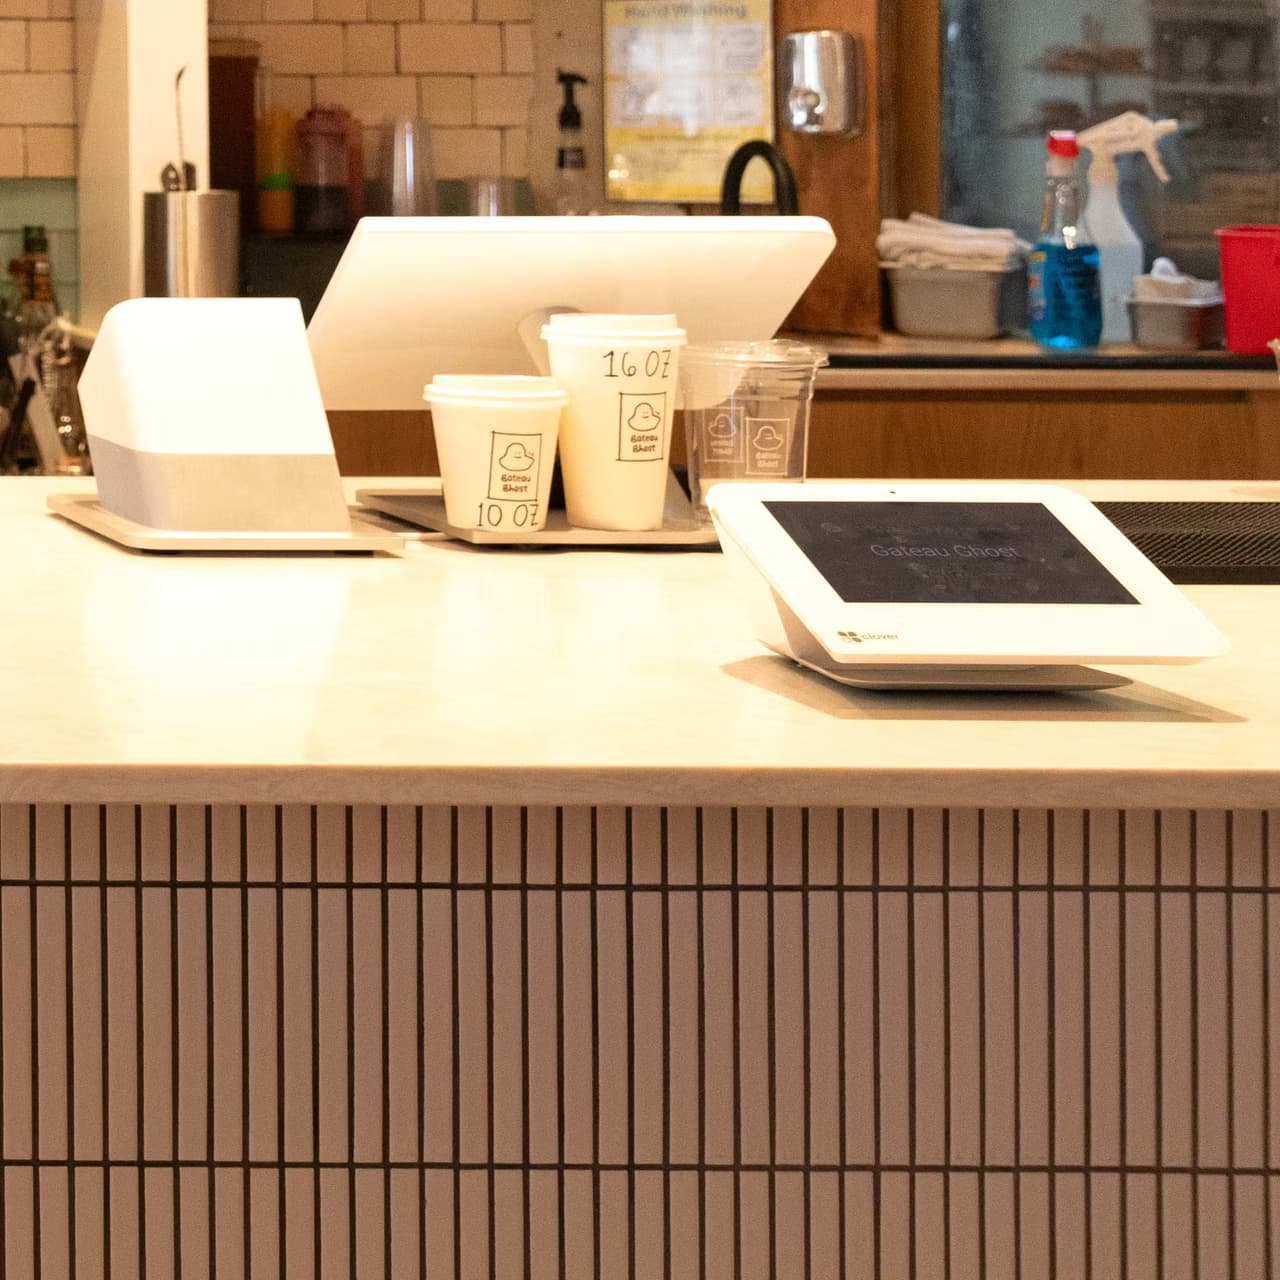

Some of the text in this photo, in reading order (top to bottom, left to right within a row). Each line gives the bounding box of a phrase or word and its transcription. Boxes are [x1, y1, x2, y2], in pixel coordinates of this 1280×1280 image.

[602, 349, 638, 378] 16
[476, 501, 503, 527] 10
[869, 543, 1024, 559] Gateau Ghost
[861, 631, 901, 640] clover
